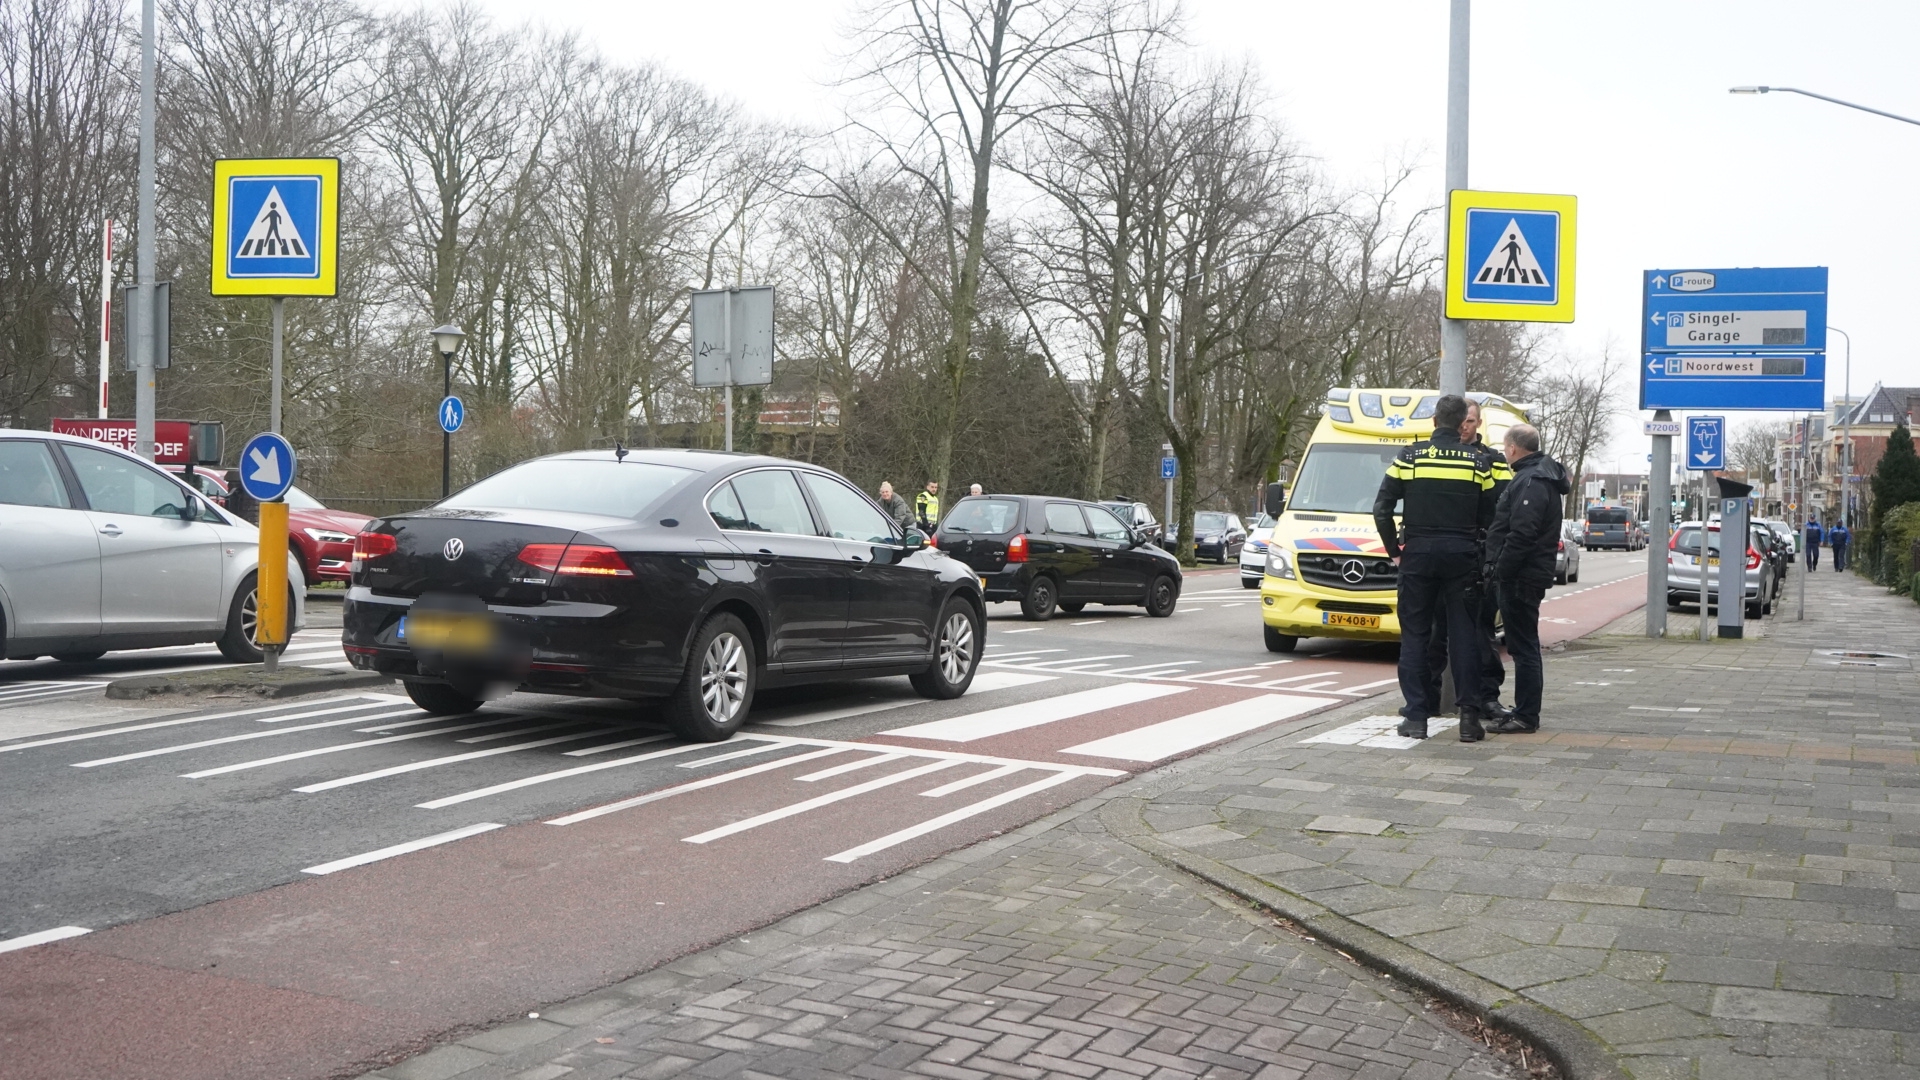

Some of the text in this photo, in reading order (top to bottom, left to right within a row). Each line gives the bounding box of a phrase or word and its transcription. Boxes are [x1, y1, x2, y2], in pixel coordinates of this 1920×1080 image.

[1688, 313, 1741, 326] Singel-
[1688, 330, 1740, 344] Garage
[1686, 362, 1754, 371] Noordwest
[1652, 424, 1680, 432] 72005
[127, 443, 183, 456] KOEF
[1726, 500, 1737, 514] P
[1330, 614, 1376, 627] SV-408-V
